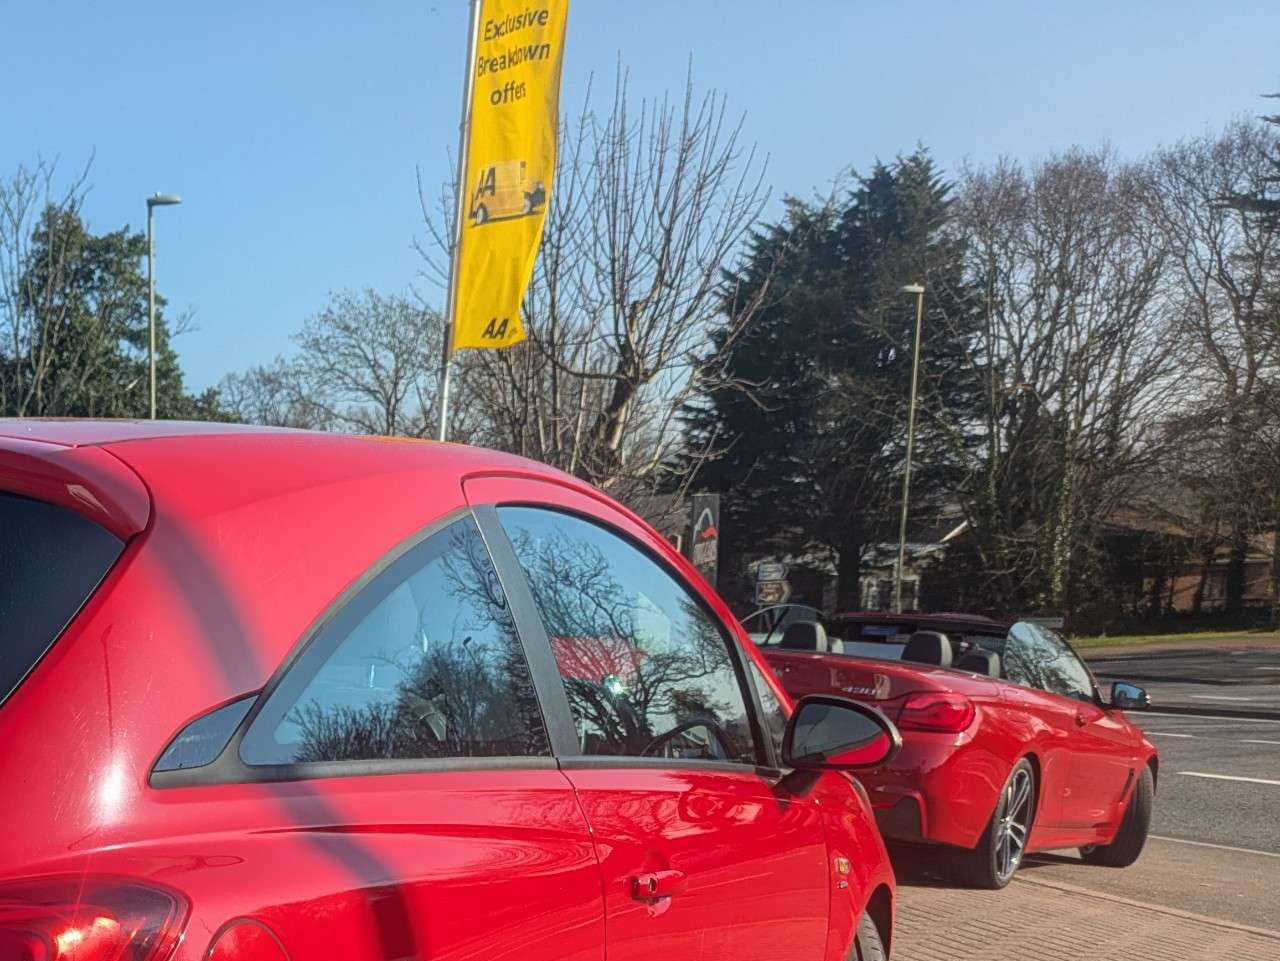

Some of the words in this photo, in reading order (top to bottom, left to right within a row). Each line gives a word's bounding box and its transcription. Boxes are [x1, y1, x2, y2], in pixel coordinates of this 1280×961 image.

[484, 8, 549, 41] Exclusive
[477, 43, 551, 77] Breakdown
[481, 317, 509, 340] AA
